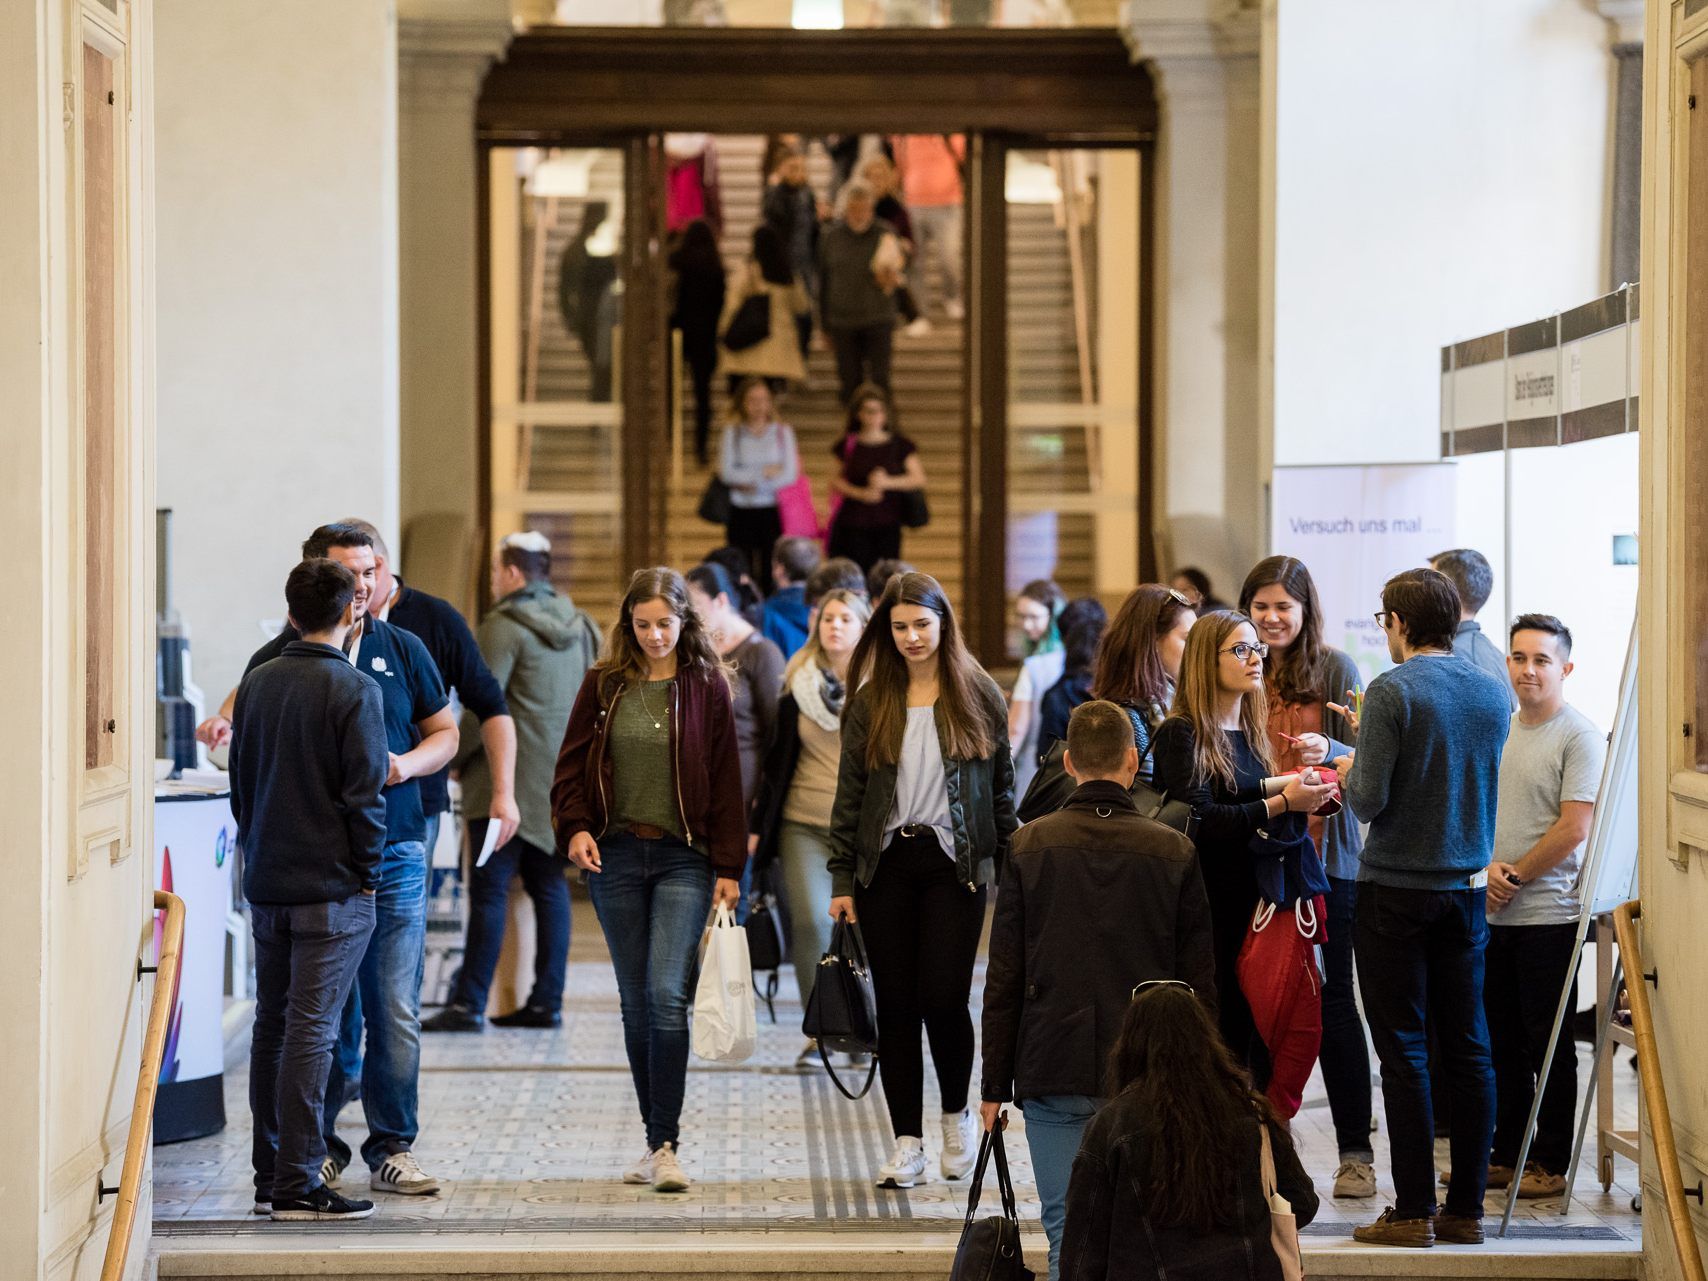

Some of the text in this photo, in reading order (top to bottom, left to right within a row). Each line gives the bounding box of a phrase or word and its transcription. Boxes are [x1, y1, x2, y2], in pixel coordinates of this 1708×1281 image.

[1289, 516, 1354, 534] Versuch
[1358, 518, 1387, 534] uns
[1392, 515, 1422, 534] mal
